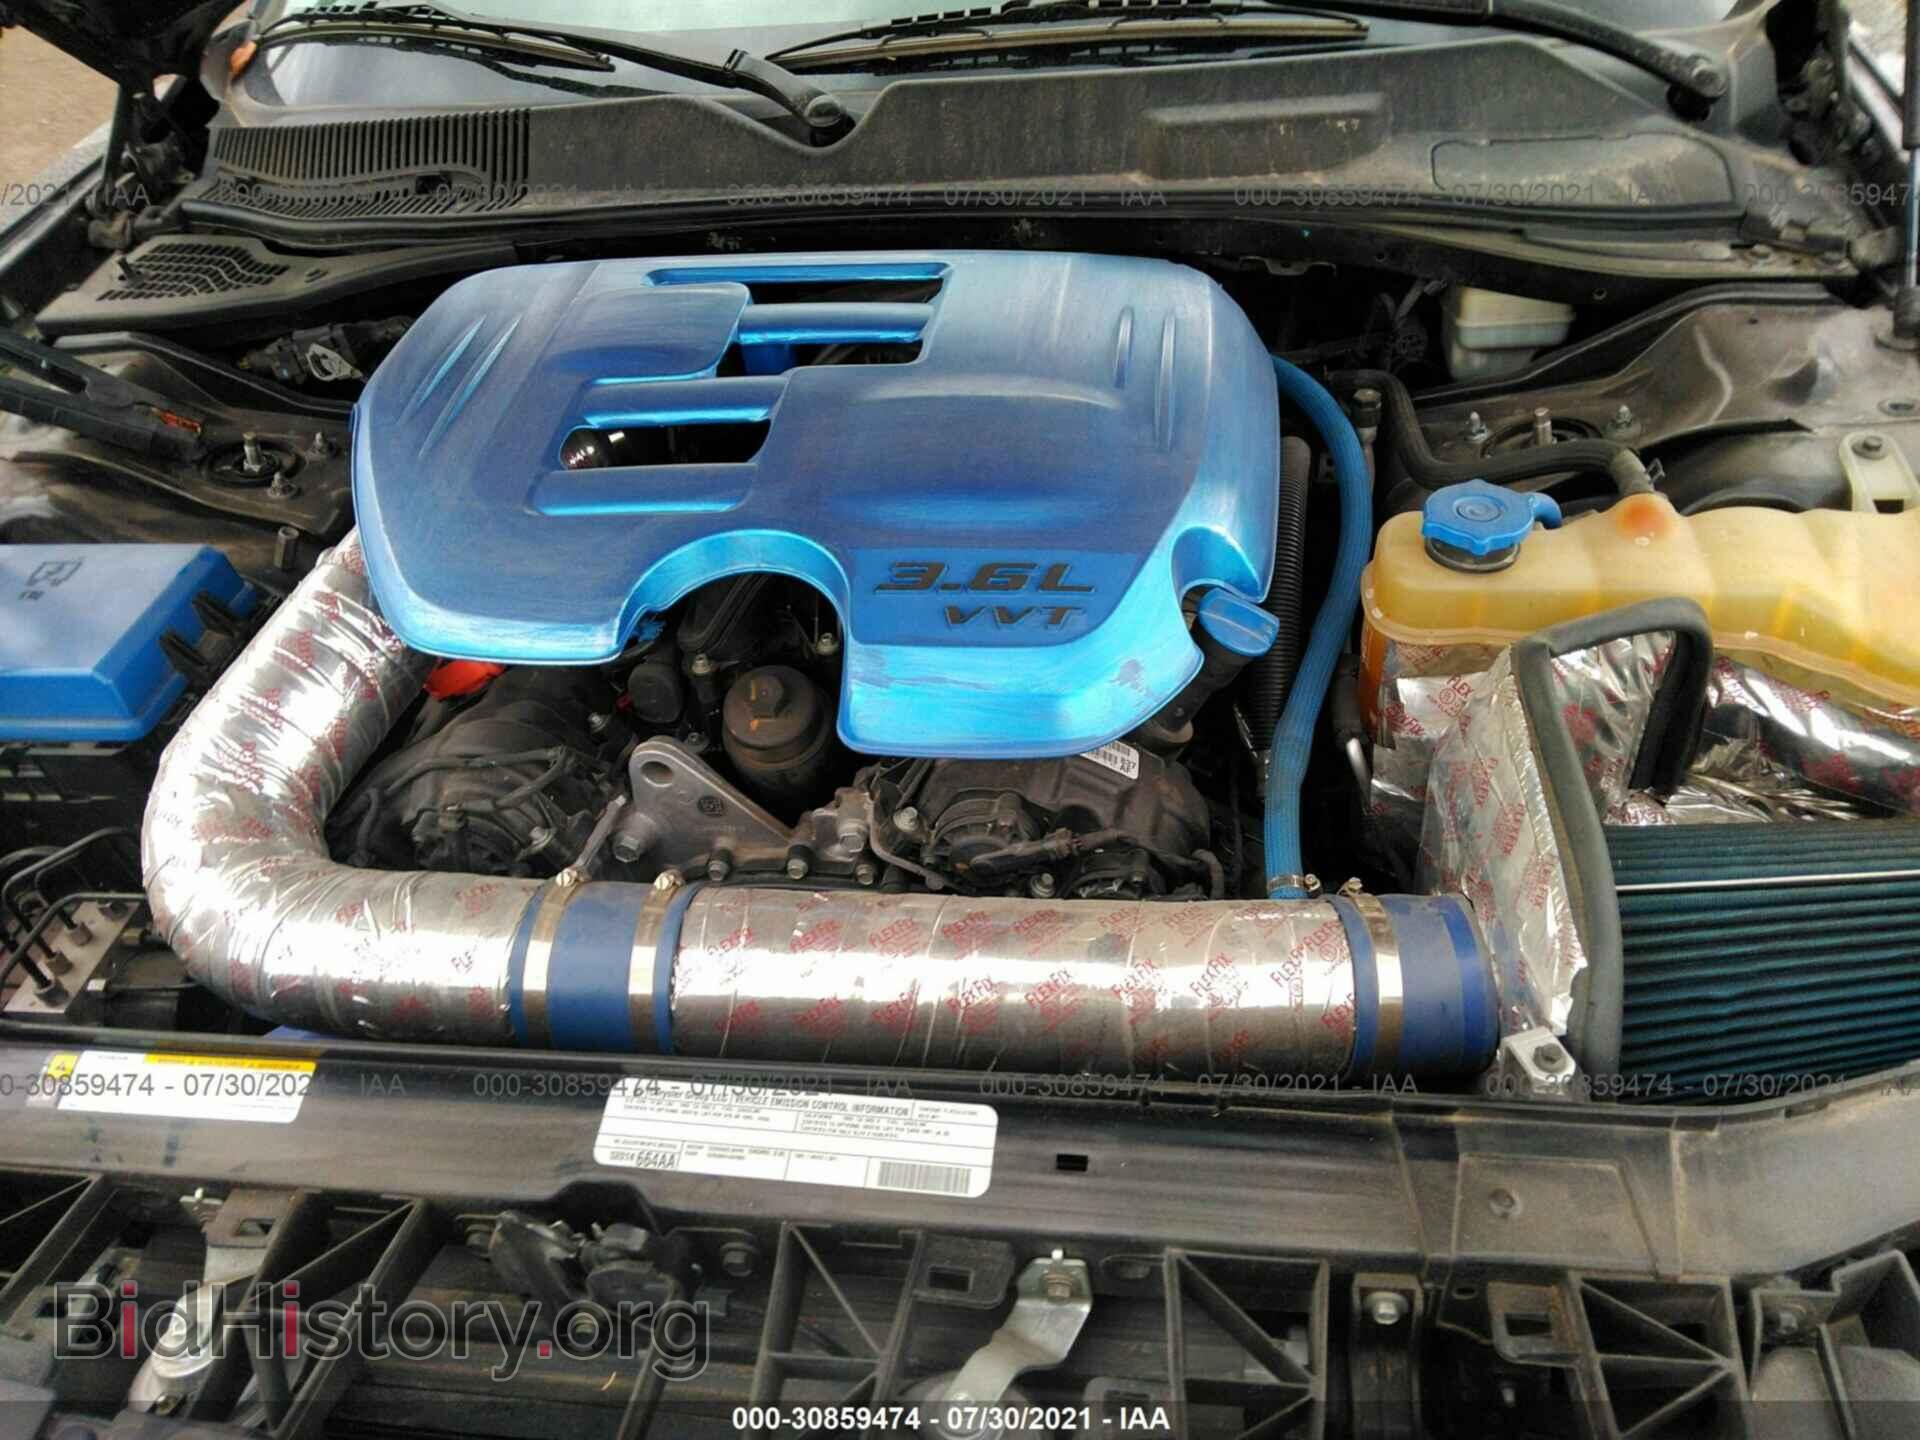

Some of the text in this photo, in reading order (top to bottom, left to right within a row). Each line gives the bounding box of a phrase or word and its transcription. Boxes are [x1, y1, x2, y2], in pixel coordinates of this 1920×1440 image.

[875, 563, 1096, 592] 3.6L
[945, 605, 1085, 628] VVT
[1024, 967, 1072, 1009] FLEXFIX
[1110, 958, 1158, 998] FLEXFIX
[1189, 951, 1233, 998] FLEXFIX
[735, 1094, 769, 1105] VEHICLE
[811, 1099, 848, 1112] CONTROL
[852, 1103, 910, 1116] INFORMATION
